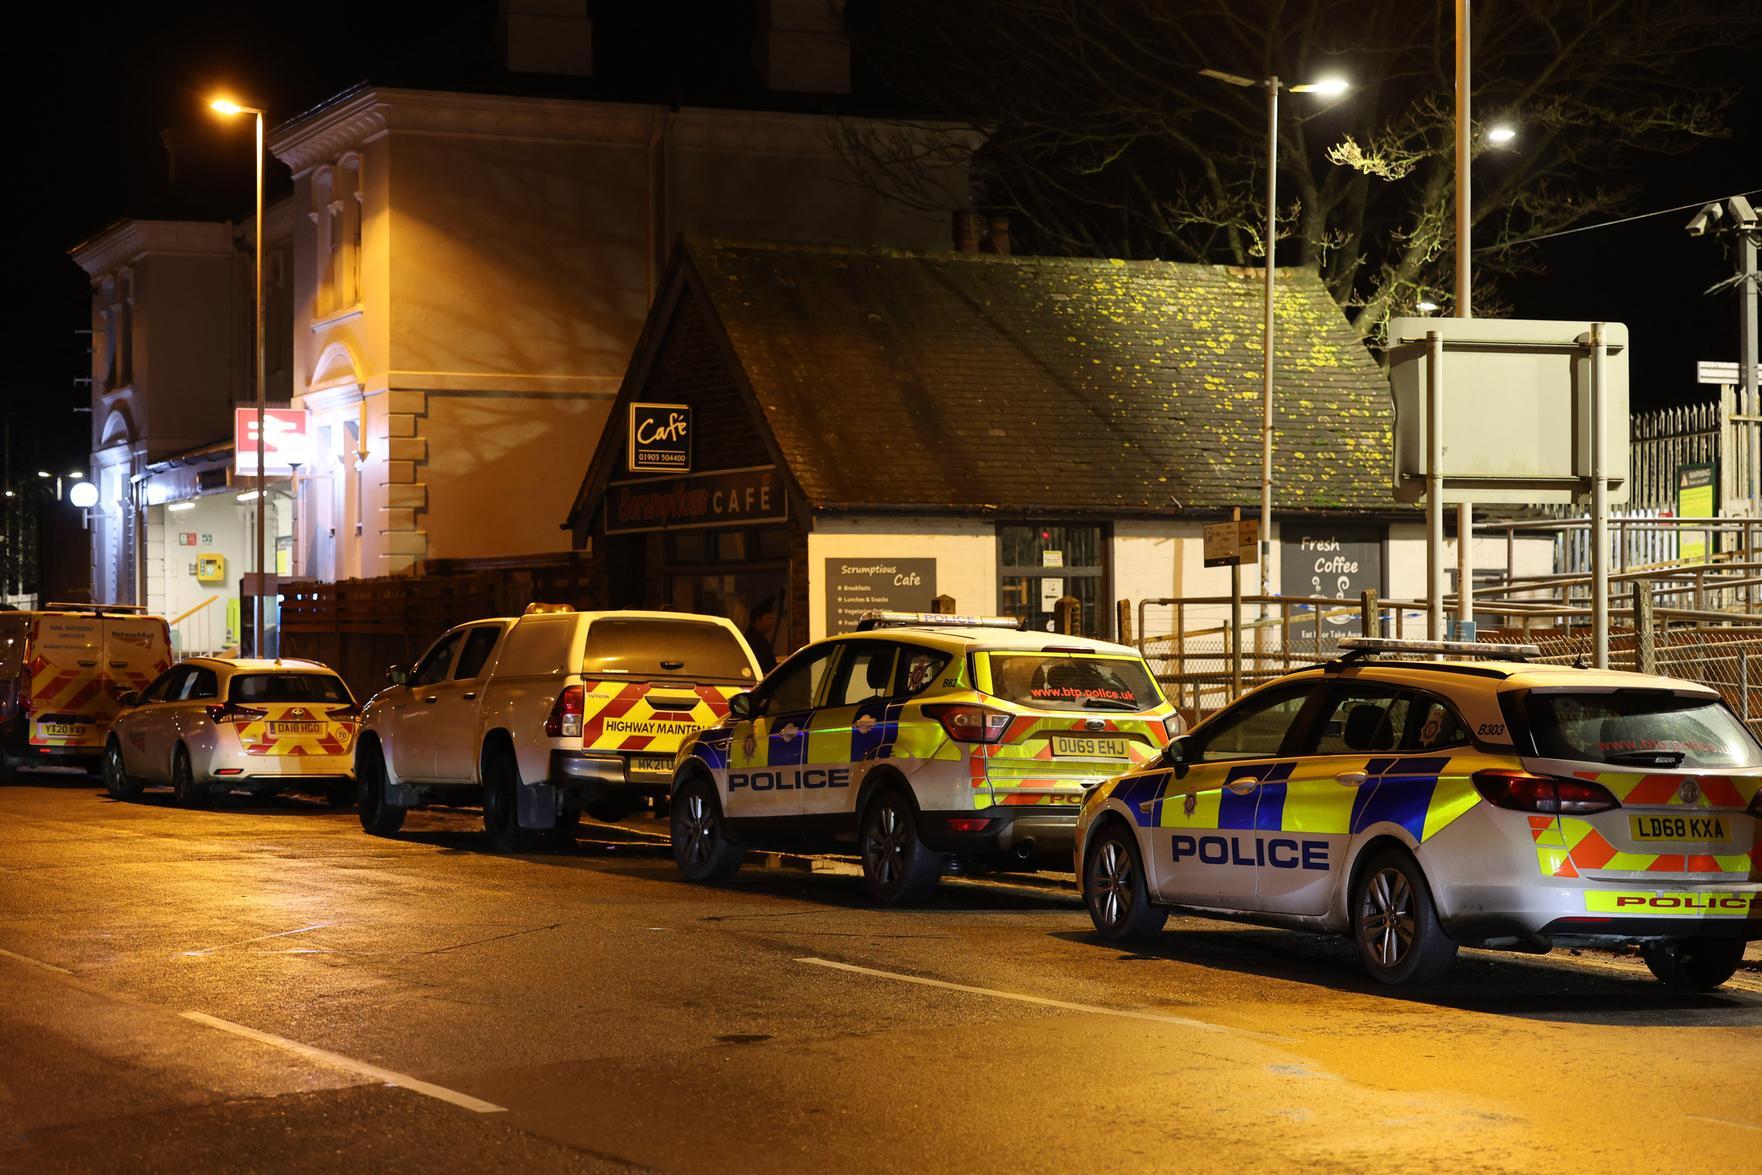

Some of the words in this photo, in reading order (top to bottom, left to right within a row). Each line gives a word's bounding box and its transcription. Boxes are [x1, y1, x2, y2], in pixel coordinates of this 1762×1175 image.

[637, 412, 687, 444] Café
[638, 453, 660, 461] 01903
[661, 454, 686, 462] 504400
[1301, 537, 1340, 551] Fresh
[841, 565, 897, 576] Scrumptious
[1314, 556, 1358, 573] Coffee
[893, 572, 921, 586] Cafe
[924, 614, 976, 624] POLICE
[1301, 630, 1313, 638] Eat
[1330, 630, 1347, 638] Take
[1031, 687, 1136, 700] www.btp.police.uk
[606, 720, 655, 734] HIGHWAY
[1478, 724, 1504, 736] B303
[337, 731, 347, 740] 70
[1059, 739, 1095, 754] OU69
[1098, 740, 1126, 755] EHJ
[728, 769, 850, 792] POLICE
[1639, 818, 1685, 837] LD68
[1690, 819, 1724, 838] KXA
[1172, 835, 1330, 871] POLICE
